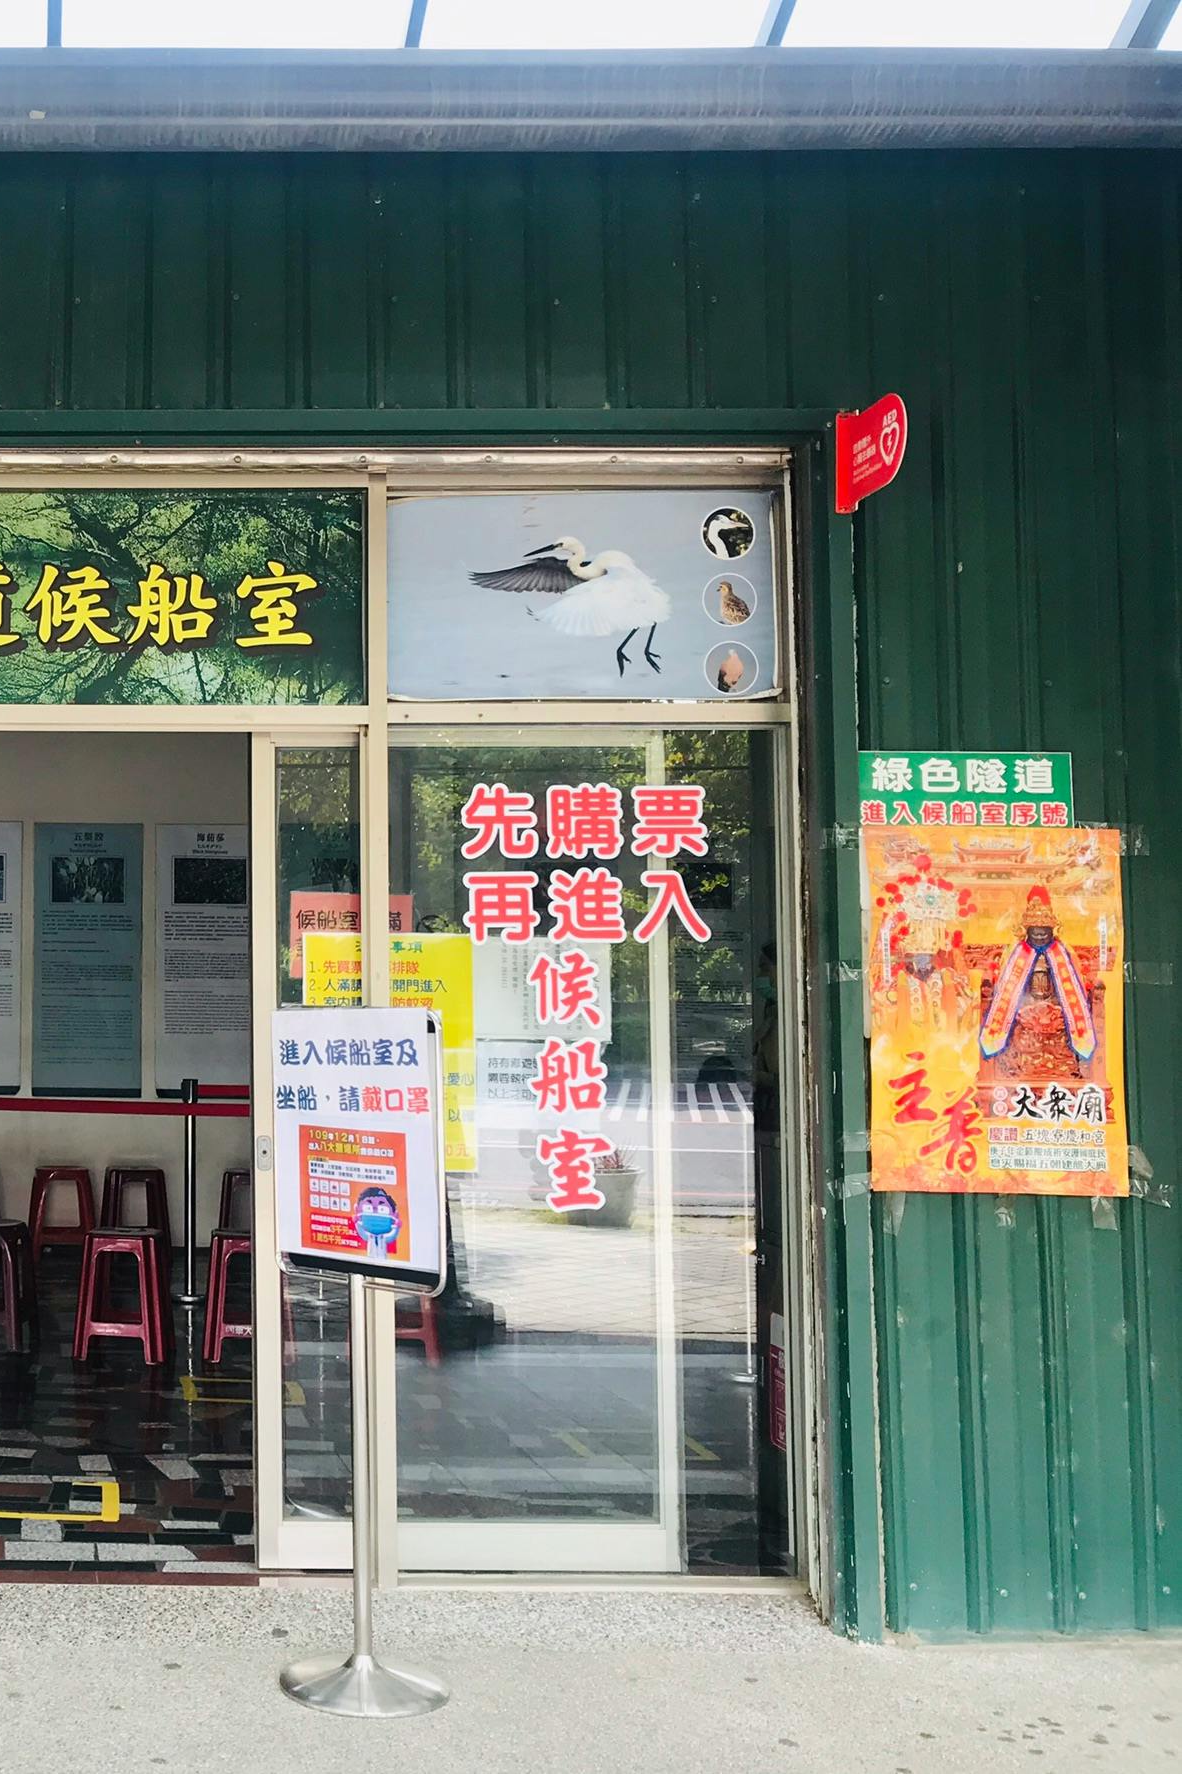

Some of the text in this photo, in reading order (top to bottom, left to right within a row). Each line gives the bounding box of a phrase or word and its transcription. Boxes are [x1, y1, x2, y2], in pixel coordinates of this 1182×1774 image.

[871, 757, 1055, 794] 綠色隧道
[463, 783, 708, 859] 先購票
[861, 802, 1069, 826] 進入候船室序號
[296, 910, 402, 931] 候船室滿
[464, 870, 712, 943] 再進入
[279, 1038, 419, 1067] 進入候船室及
[530, 952, 614, 1209] 候船室
[275, 1085, 431, 1114] 坐船，請戴口罩
